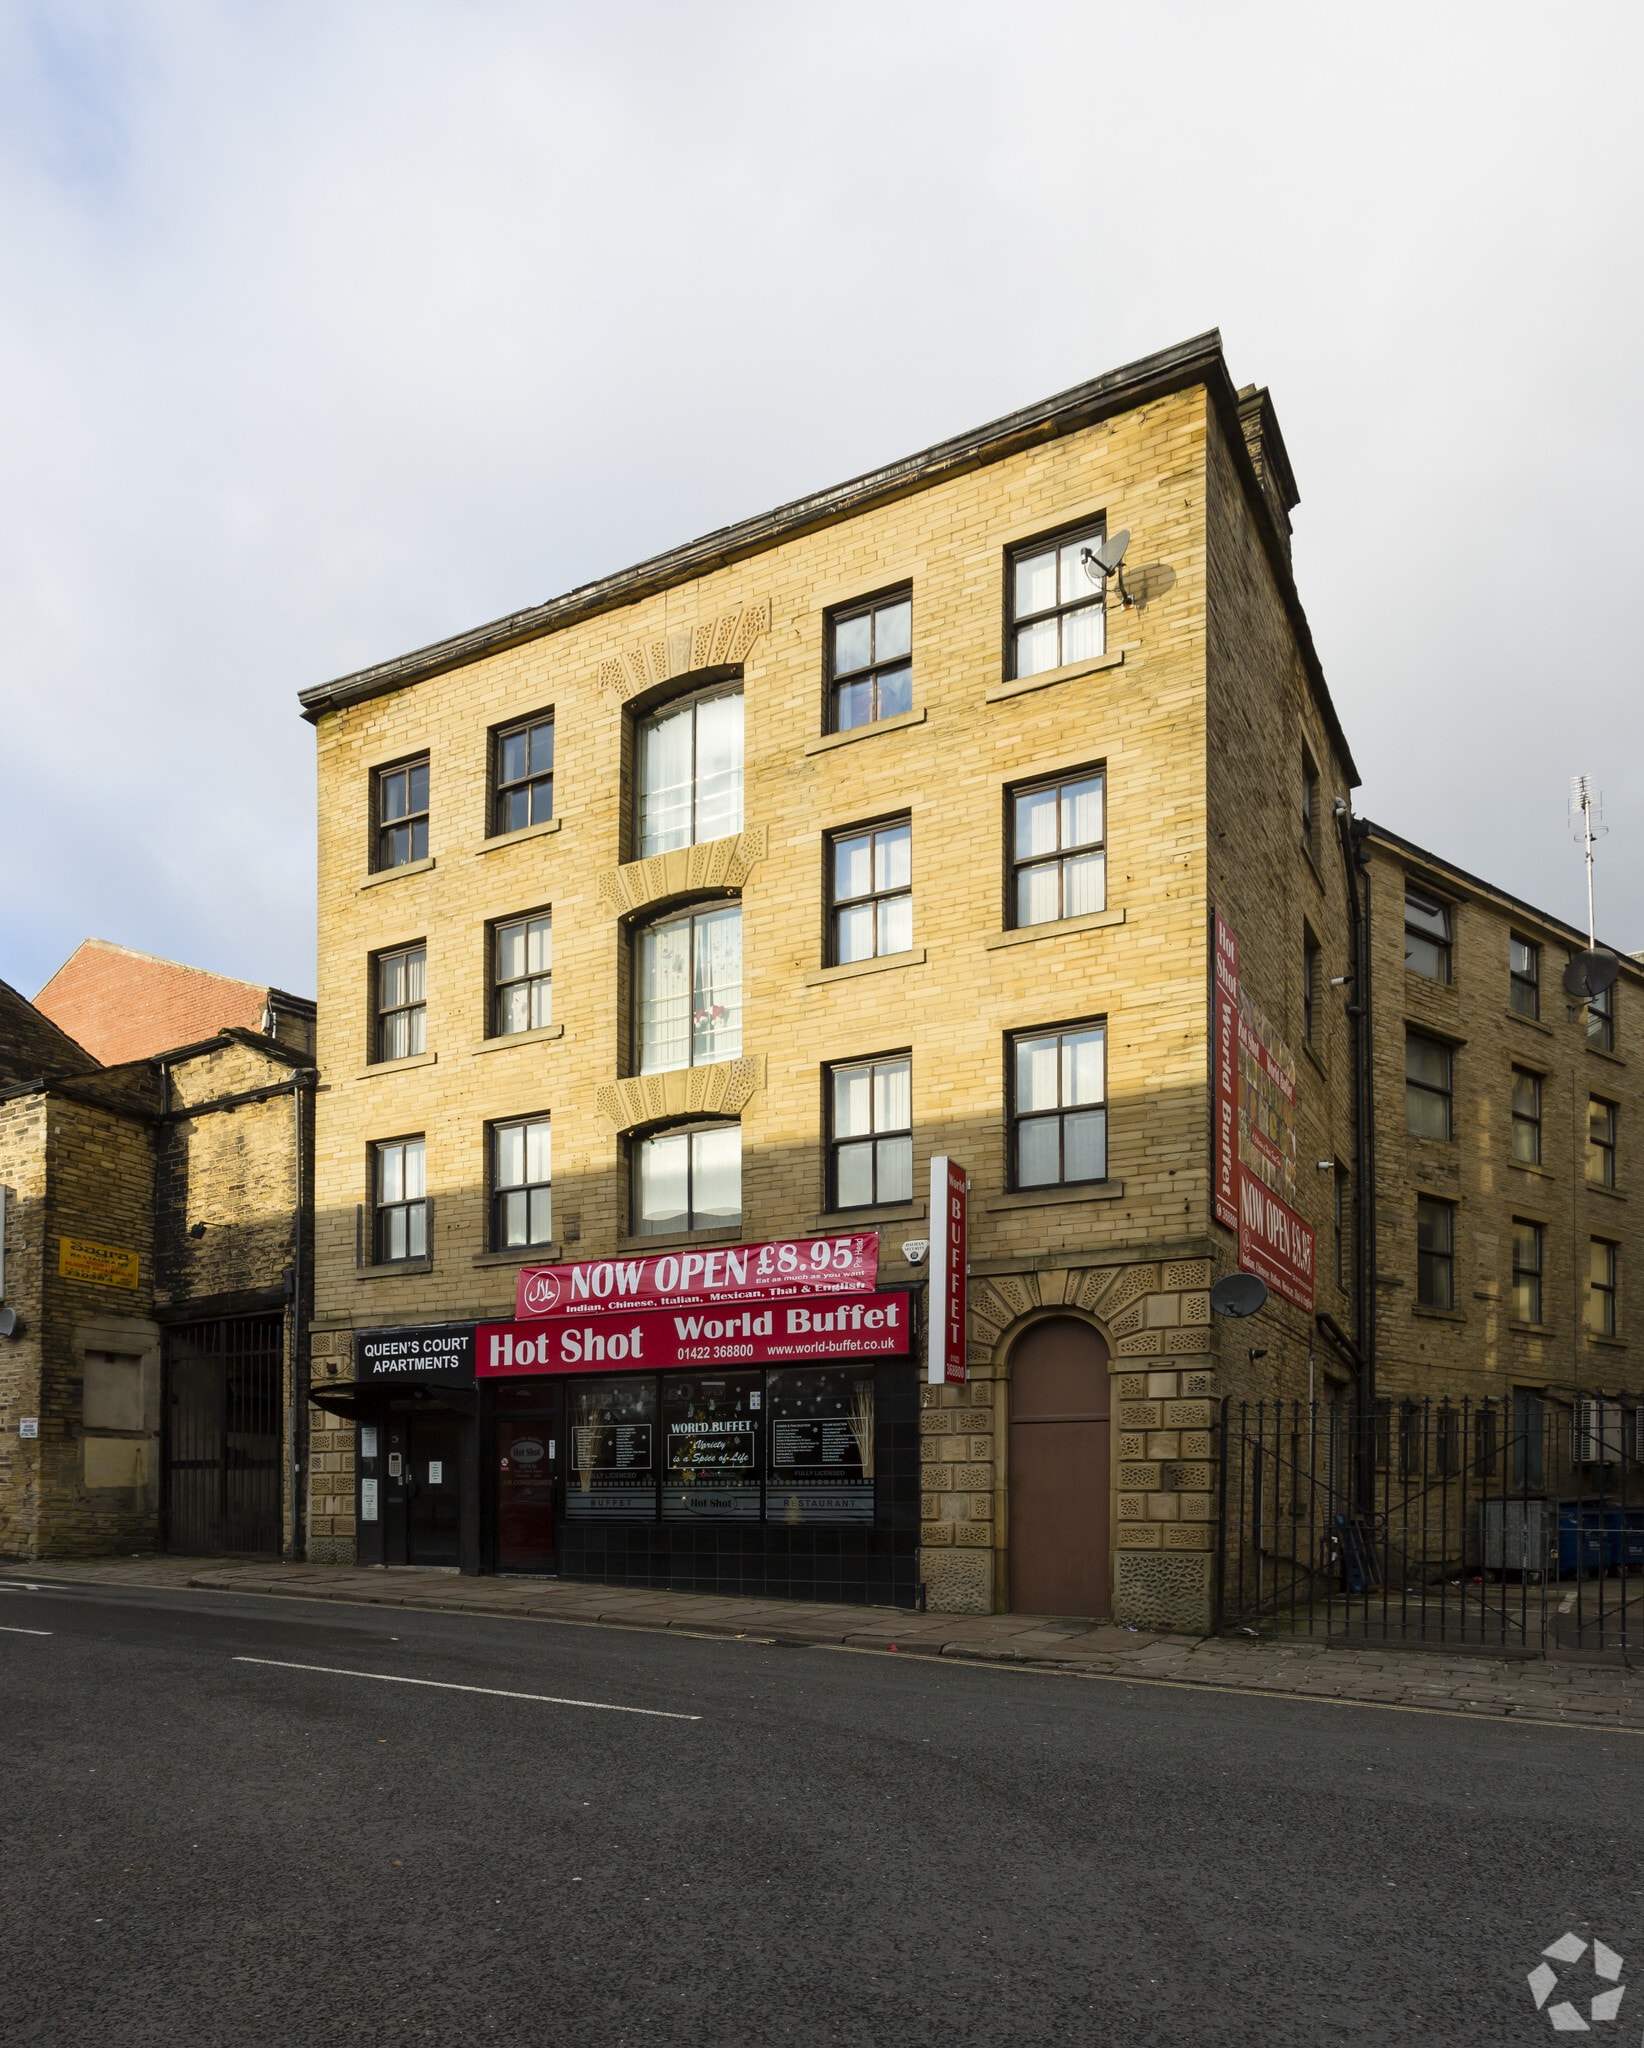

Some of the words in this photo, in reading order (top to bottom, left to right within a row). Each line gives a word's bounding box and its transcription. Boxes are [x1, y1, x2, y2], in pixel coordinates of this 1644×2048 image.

[1219, 920, 1235, 964] Hot
[1216, 951, 1237, 999] Shot
[1222, 1002, 1232, 1095] World
[1222, 1099, 1232, 1197] Buffet
[948, 1173, 966, 1194] World
[1241, 1175, 1264, 1236] NOW
[1266, 1199, 1291, 1257] OPEN
[70, 1240, 129, 1261] Sagra
[854, 1238, 864, 1256] Head
[70, 1252, 129, 1268] RESTAURANT
[756, 1239, 853, 1276] £8.95
[853, 1255, 863, 1268] Per
[570, 1260, 647, 1300] NOW
[654, 1249, 749, 1292] OPEN
[950, 1197, 962, 1344] BUFFET
[566, 1303, 605, 1313] Indian,
[608, 1299, 658, 1310] Chinese,
[661, 1295, 704, 1305] Italian,
[709, 1289, 765, 1301] Mexican,
[768, 1286, 797, 1296] Thai
[801, 1285, 812, 1293] &
[815, 1281, 866, 1292] English
[674, 1311, 773, 1341] World
[787, 1302, 900, 1335] Buffet
[364, 1341, 420, 1357] QUEEN'S
[423, 1337, 469, 1353] COURT
[489, 1332, 549, 1367] Hot
[560, 1325, 644, 1363] Shot
[677, 1346, 710, 1360] 01422
[713, 1344, 754, 1359] 368800
[767, 1337, 895, 1356] www.world-buffet.co.uk
[373, 1355, 459, 1373] APARTMENTS
[671, 1422, 709, 1433] WORLD
[712, 1420, 752, 1432] BUFFET
[513, 1448, 525, 1457] Hot
[525, 1447, 541, 1457] Shot
[695, 1440, 726, 1450] Variety
[692, 1453, 716, 1464] Spice
[719, 1453, 728, 1464] of
[730, 1452, 749, 1463] Life
[590, 1499, 633, 1507] BUFFET
[690, 1499, 707, 1508] Hot
[709, 1499, 732, 1509] Shot
[783, 1499, 857, 1508] RESTAURANT
